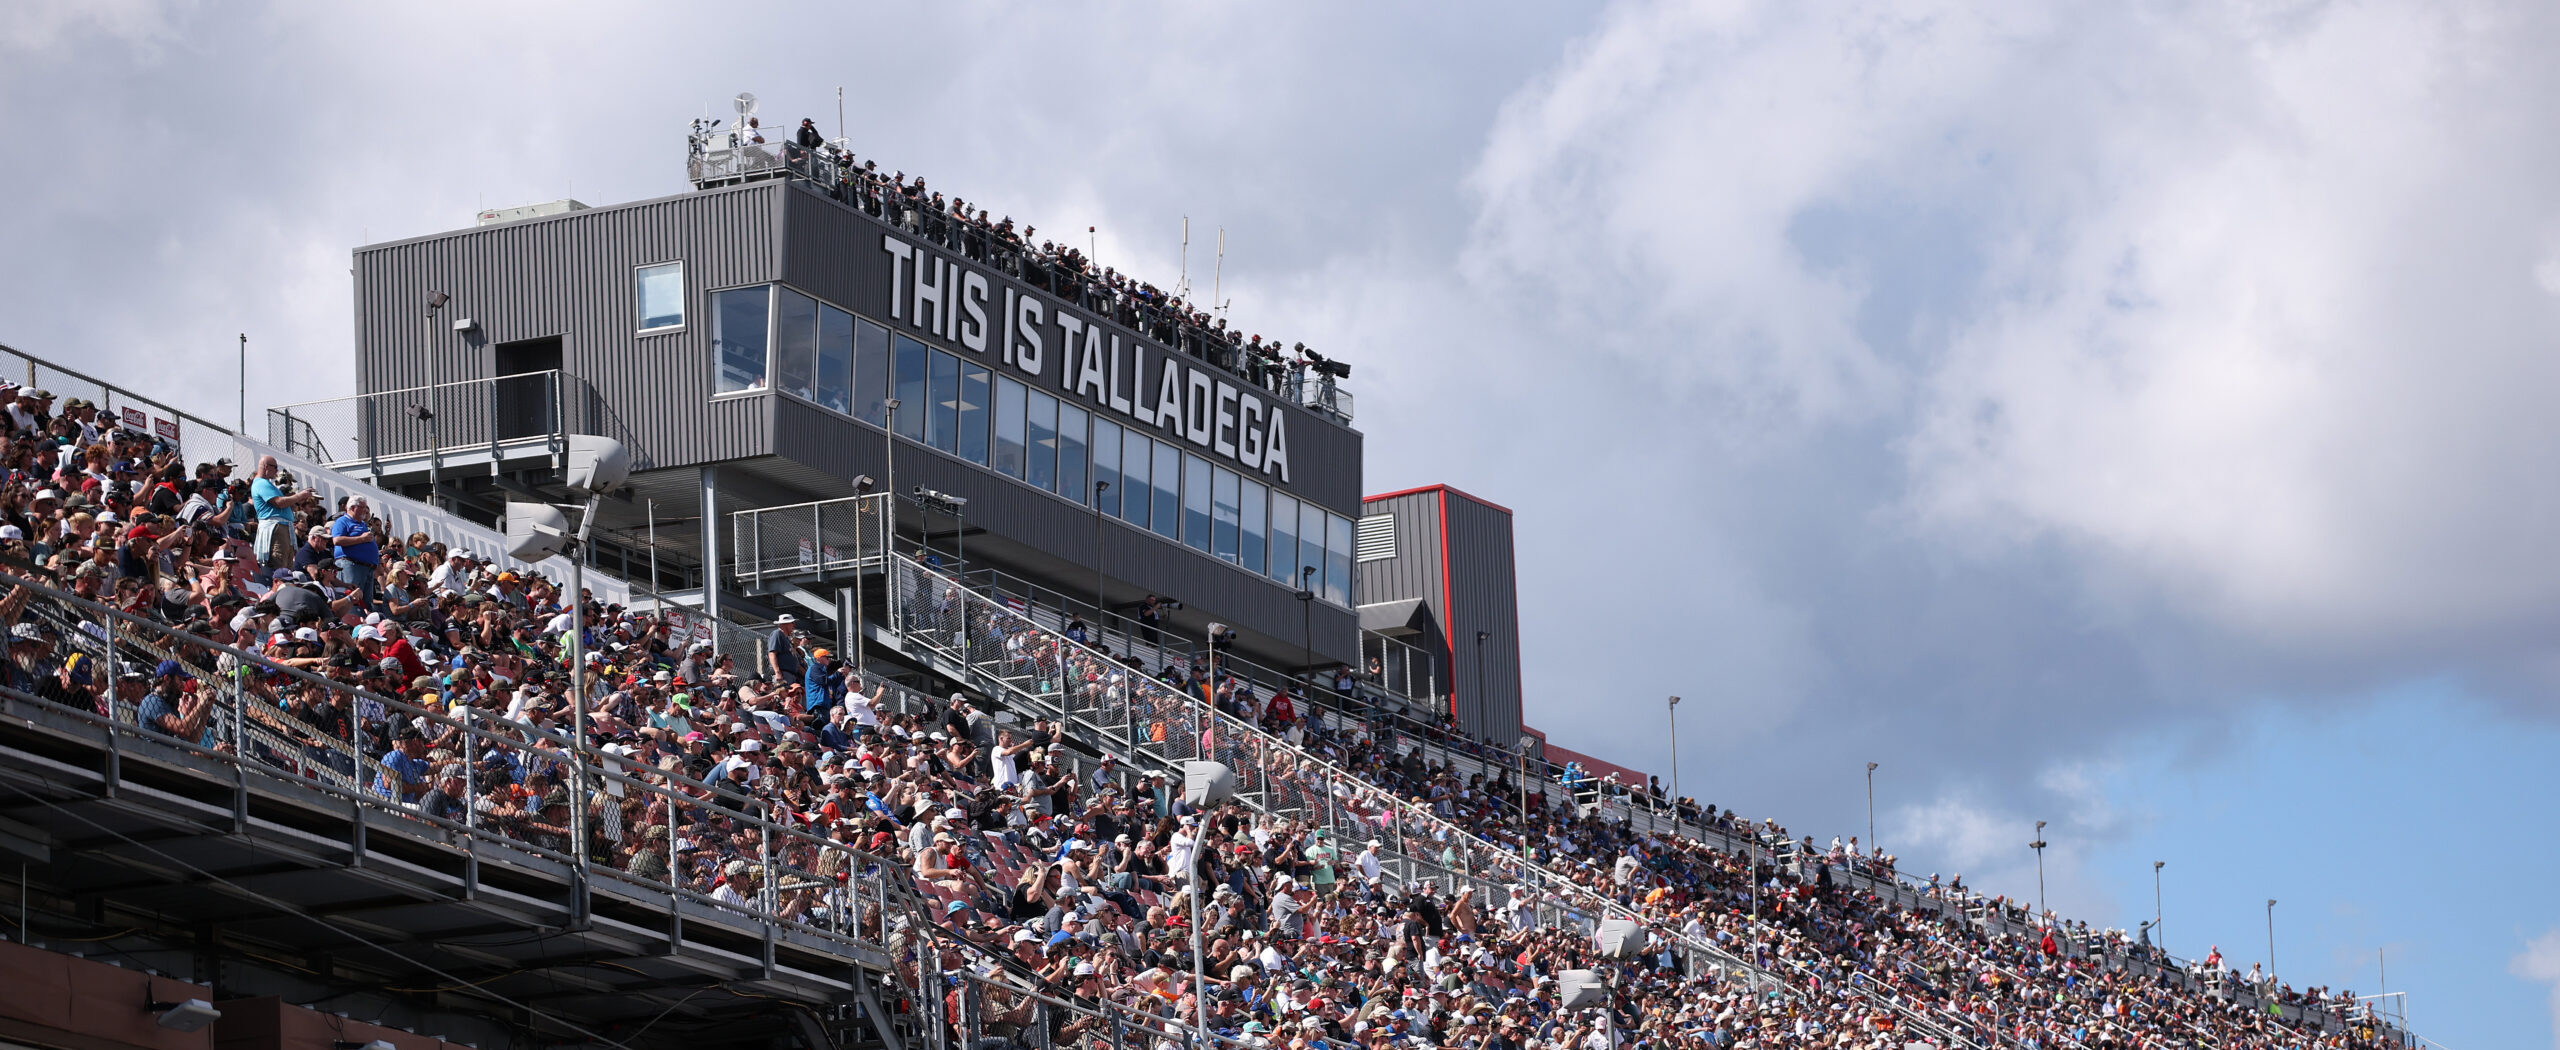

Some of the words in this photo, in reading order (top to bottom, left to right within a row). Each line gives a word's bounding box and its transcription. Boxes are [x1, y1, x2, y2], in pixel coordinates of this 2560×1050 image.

[883, 234, 990, 353] THIS
[1003, 286, 1045, 376] IS
[1056, 310, 1290, 483] TALLADEGA
